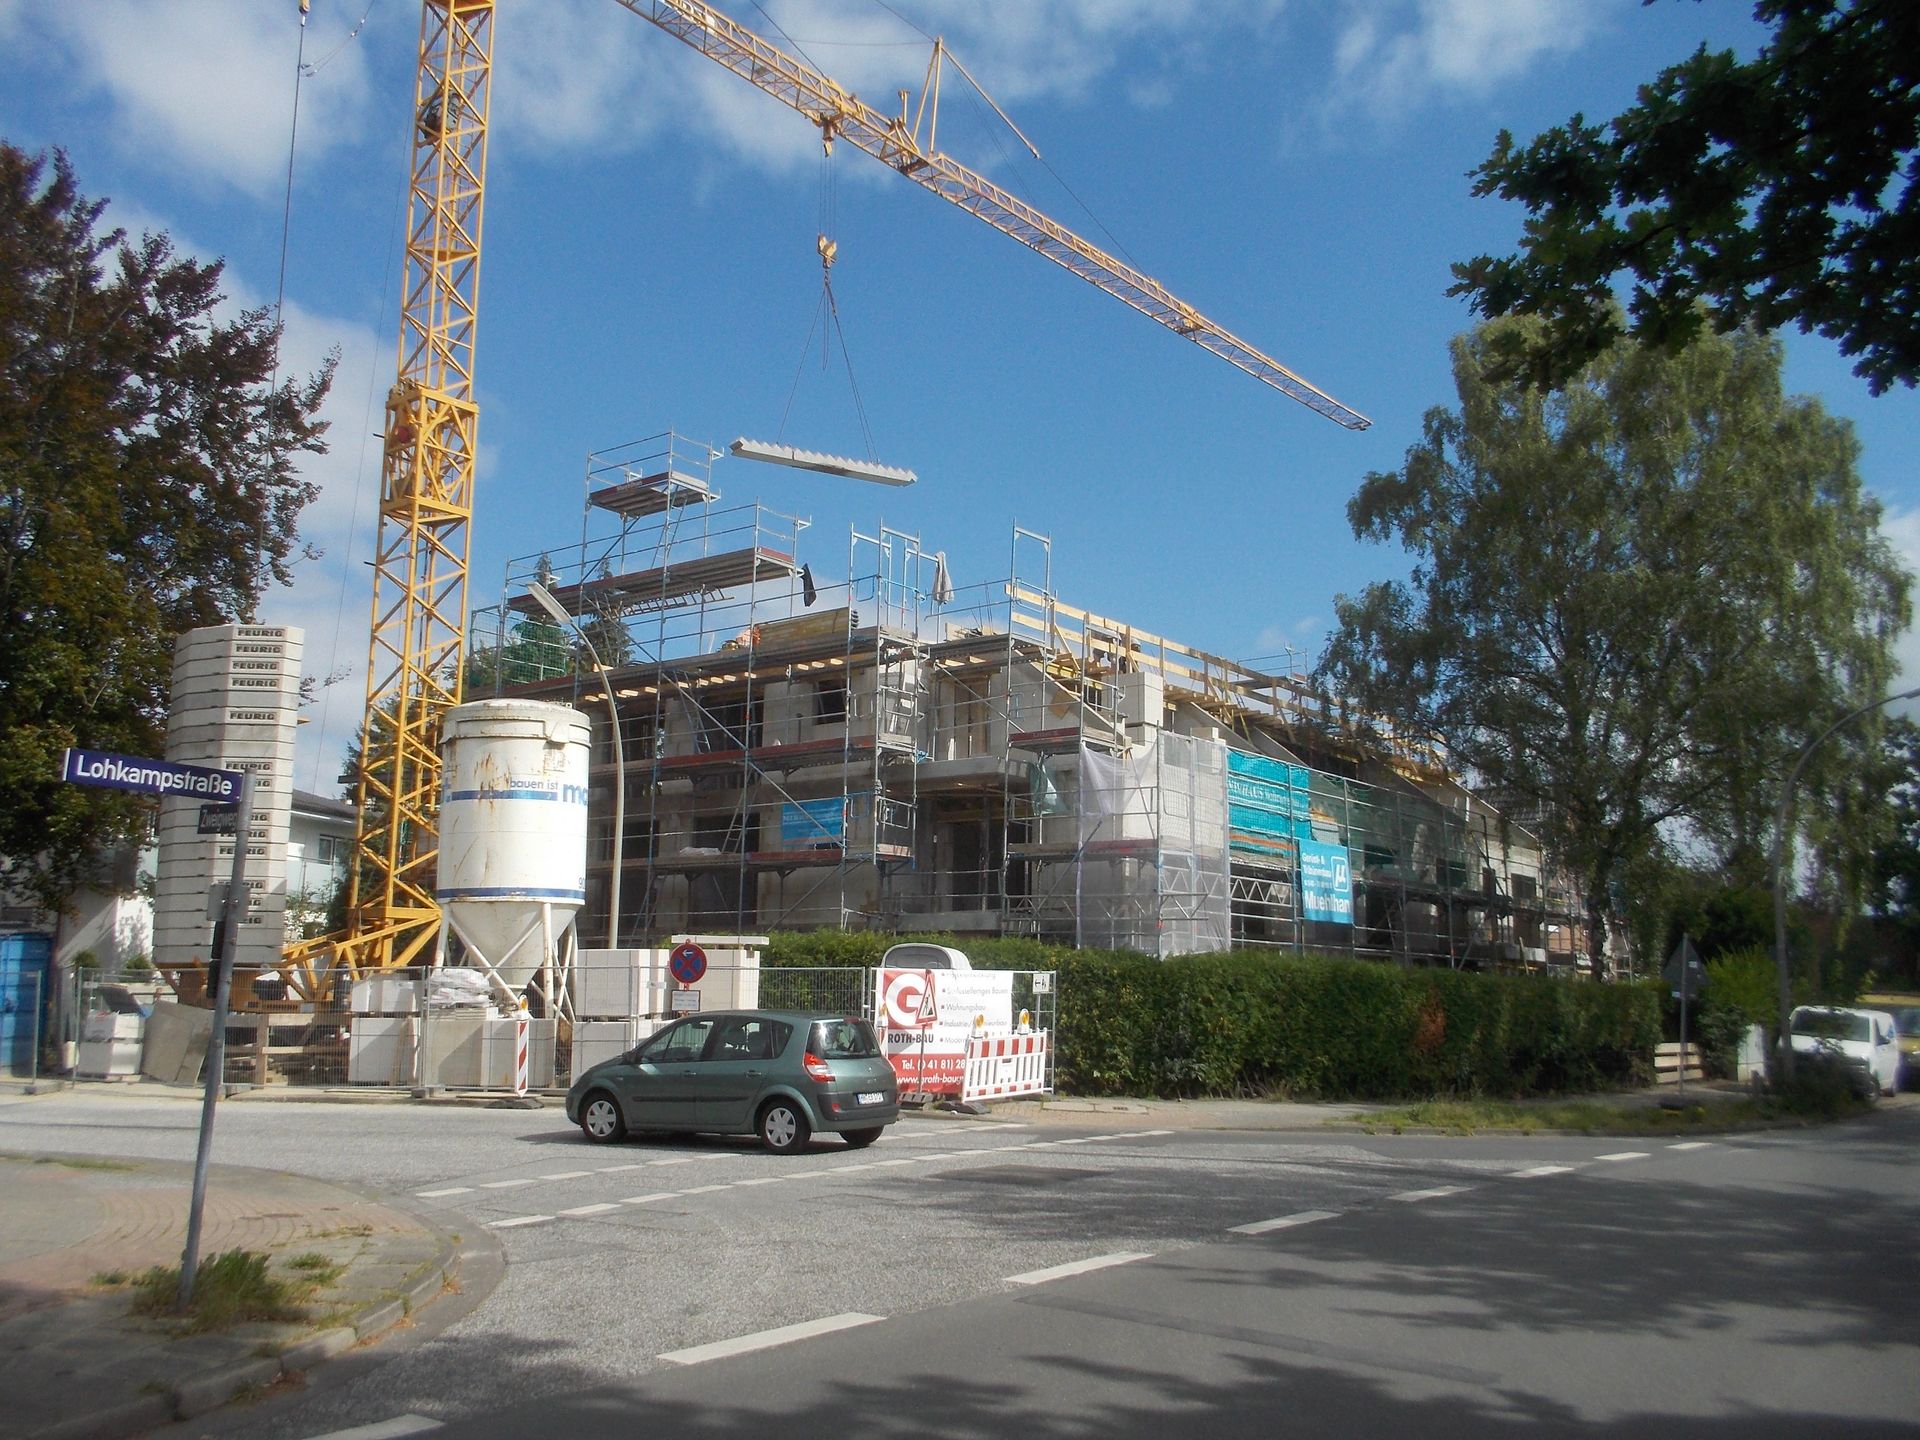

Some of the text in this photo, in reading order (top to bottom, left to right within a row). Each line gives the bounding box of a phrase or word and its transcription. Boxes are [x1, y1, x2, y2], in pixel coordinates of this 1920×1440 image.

[237, 628, 283, 637] FEURIG
[236, 645, 281, 653] FEURIG
[232, 662, 278, 670] FEURIG
[231, 679, 277, 687] FEURIG
[229, 712, 275, 720] FEURIG
[76, 754, 233, 796] Lohkampstraße
[901, 1059, 915, 1069] Tel.
[927, 1059, 937, 1069] 41
[940, 1059, 954, 1071] 81)
